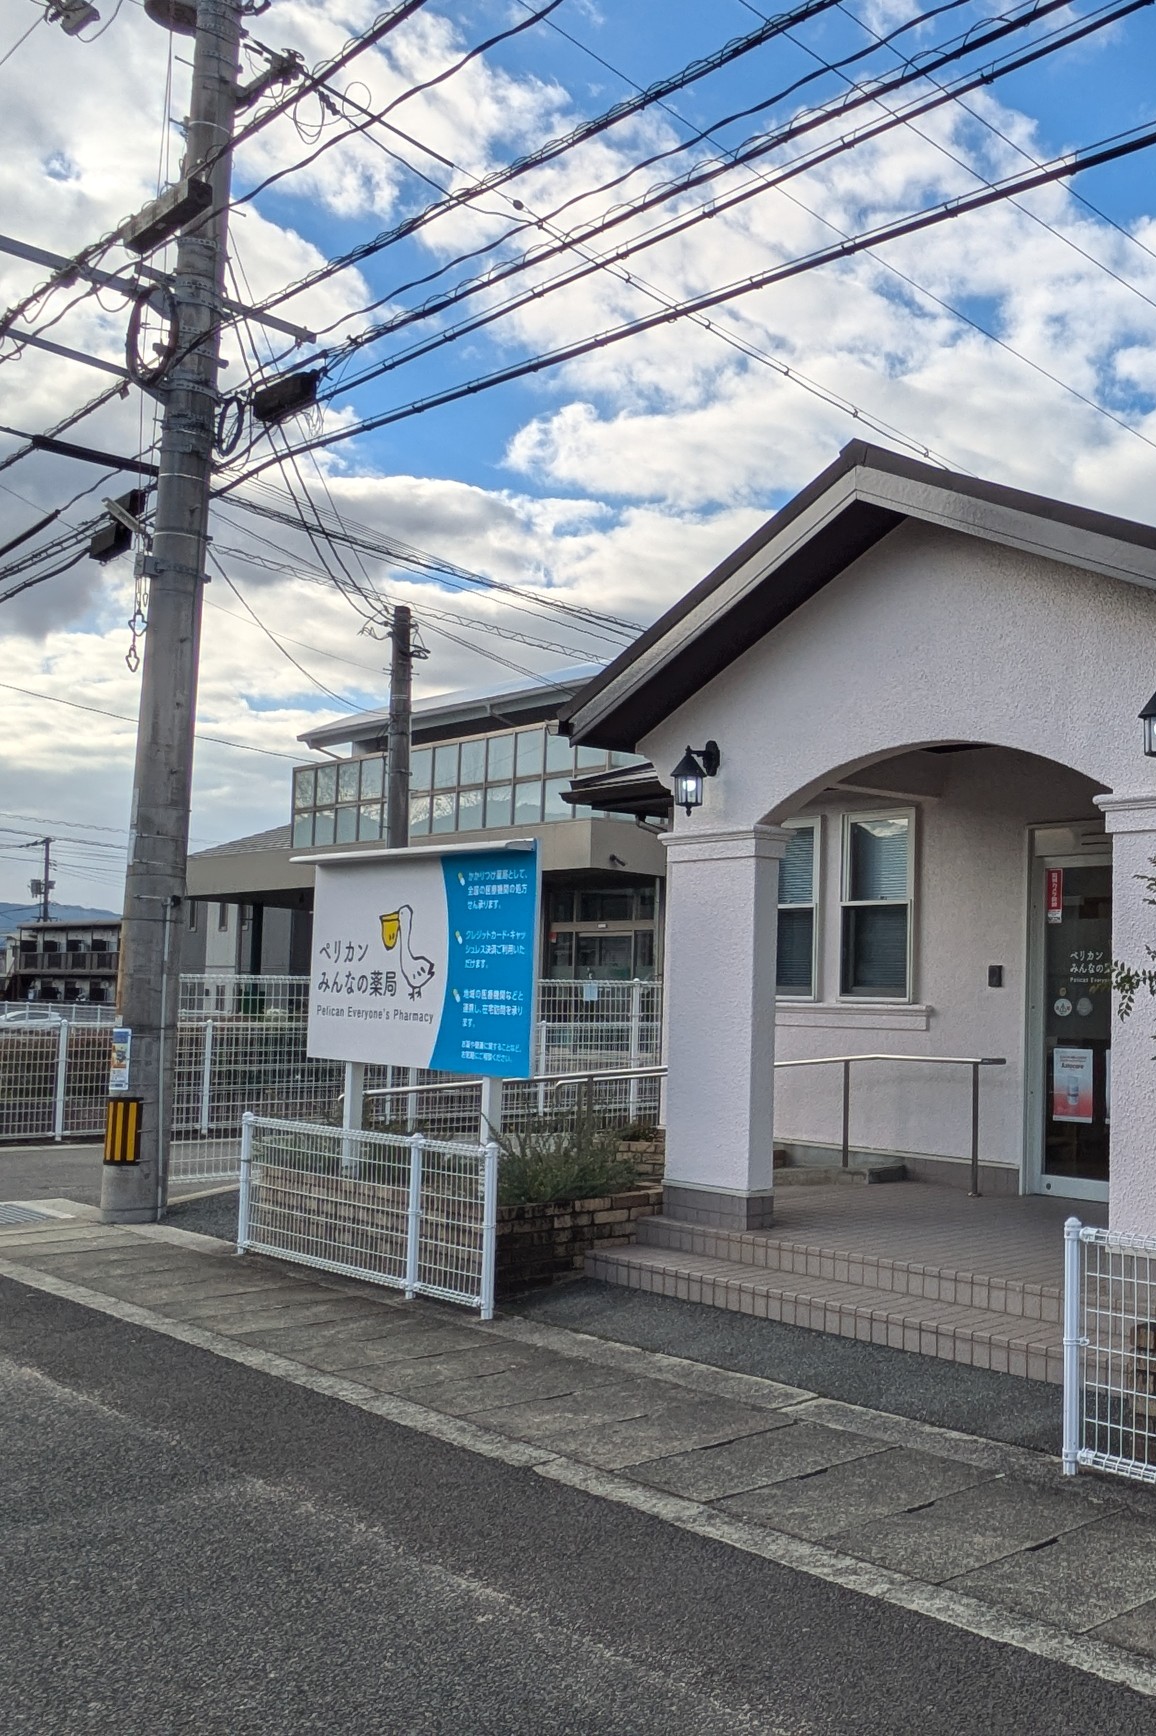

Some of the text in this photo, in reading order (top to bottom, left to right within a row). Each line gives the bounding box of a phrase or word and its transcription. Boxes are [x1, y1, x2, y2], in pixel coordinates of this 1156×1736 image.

[319, 940, 369, 963] ペリカン
[318, 970, 397, 997] みんなの薬局
[316, 1004, 434, 1025] Pelican Everyone's Pharmacy
